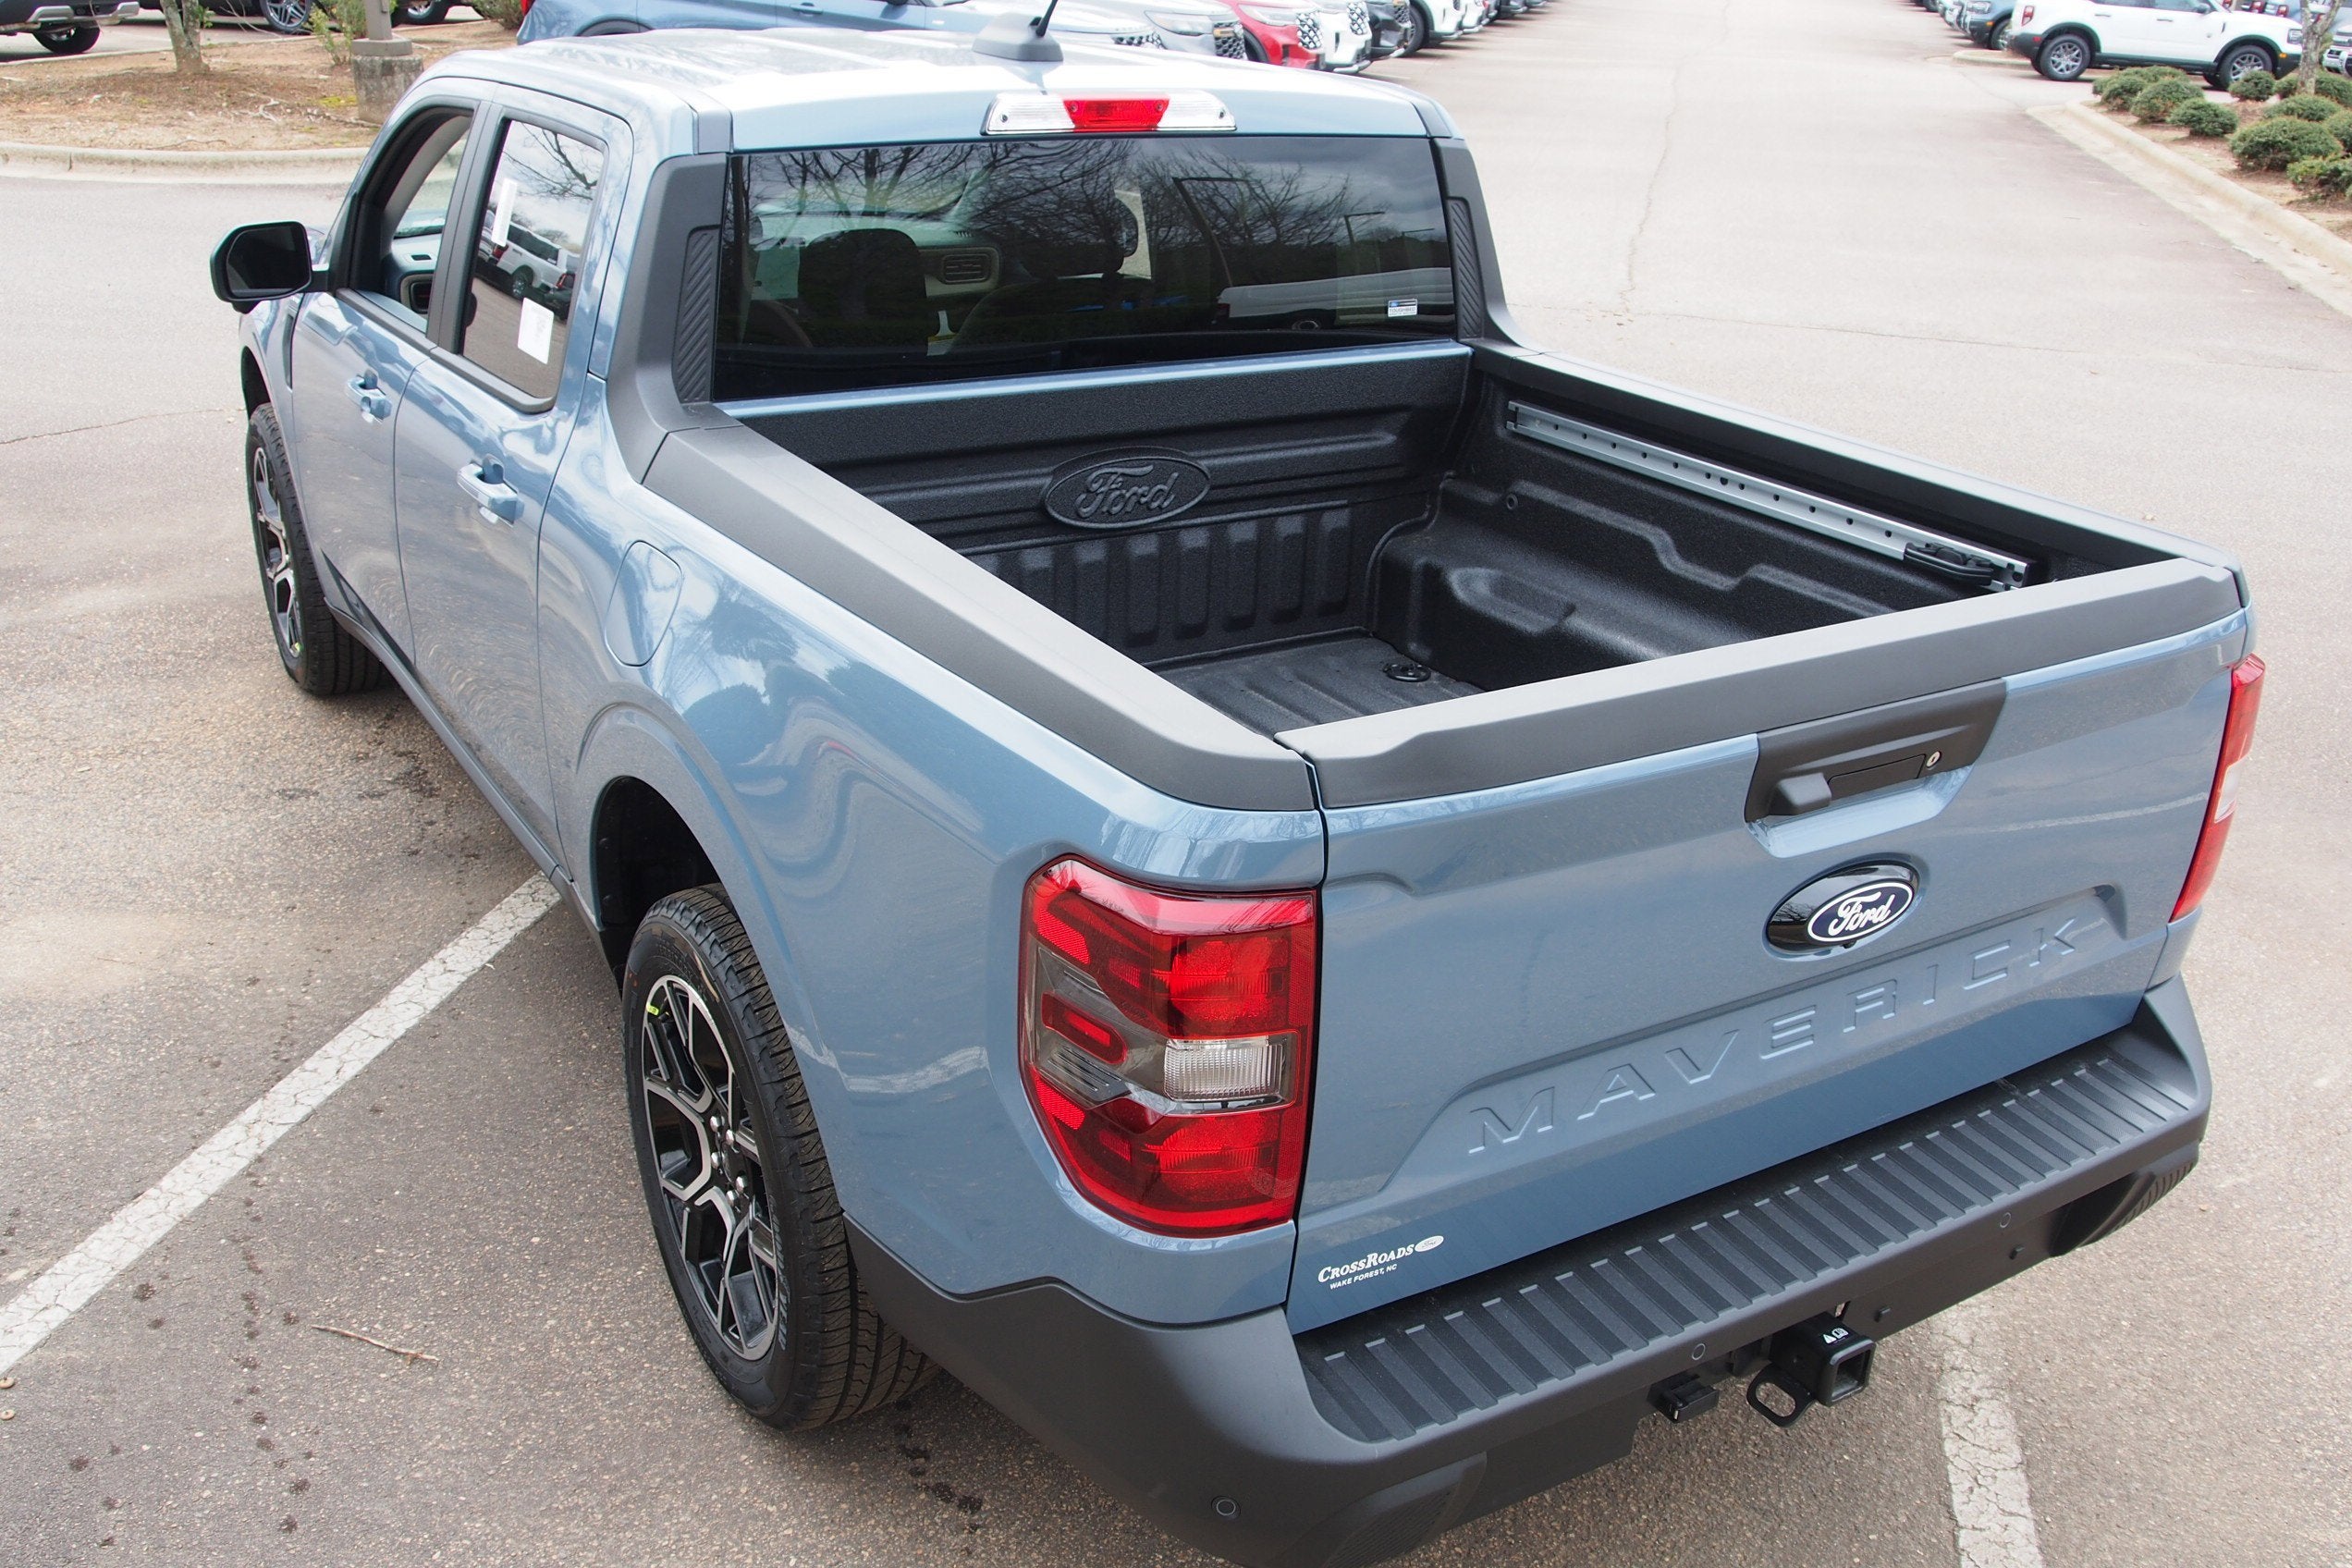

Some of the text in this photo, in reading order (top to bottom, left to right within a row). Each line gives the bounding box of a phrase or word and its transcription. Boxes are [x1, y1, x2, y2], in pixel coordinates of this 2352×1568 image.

[1074, 464, 1179, 519] Ford
[1827, 890, 1895, 937] Ford
[1467, 917, 2076, 1154] MAVERICK
[1329, 1263, 1398, 1290] WAKE FOREST, NC
